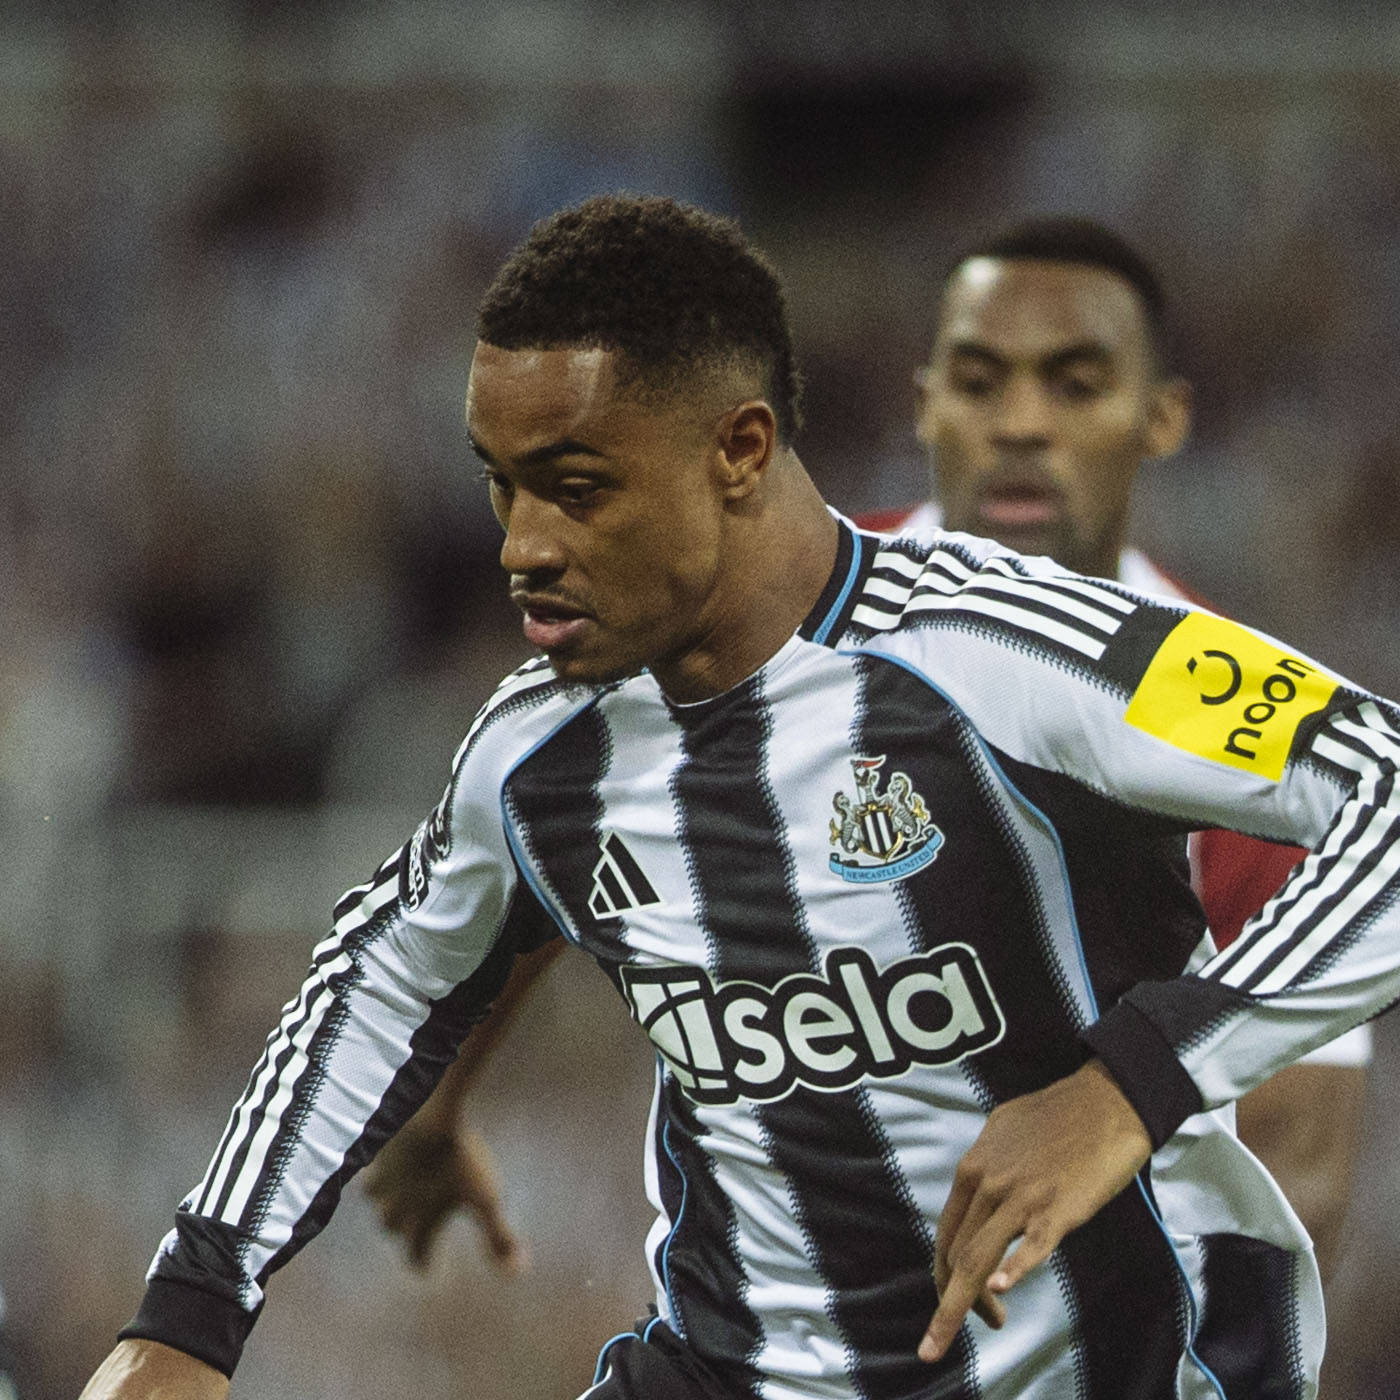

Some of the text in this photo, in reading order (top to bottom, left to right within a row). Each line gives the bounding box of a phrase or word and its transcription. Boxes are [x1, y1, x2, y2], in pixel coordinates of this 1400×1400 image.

[1223, 658, 1316, 761] noon
[846, 850, 930, 880] NEWCASTLE UNITED
[722, 960, 988, 1084] sela
